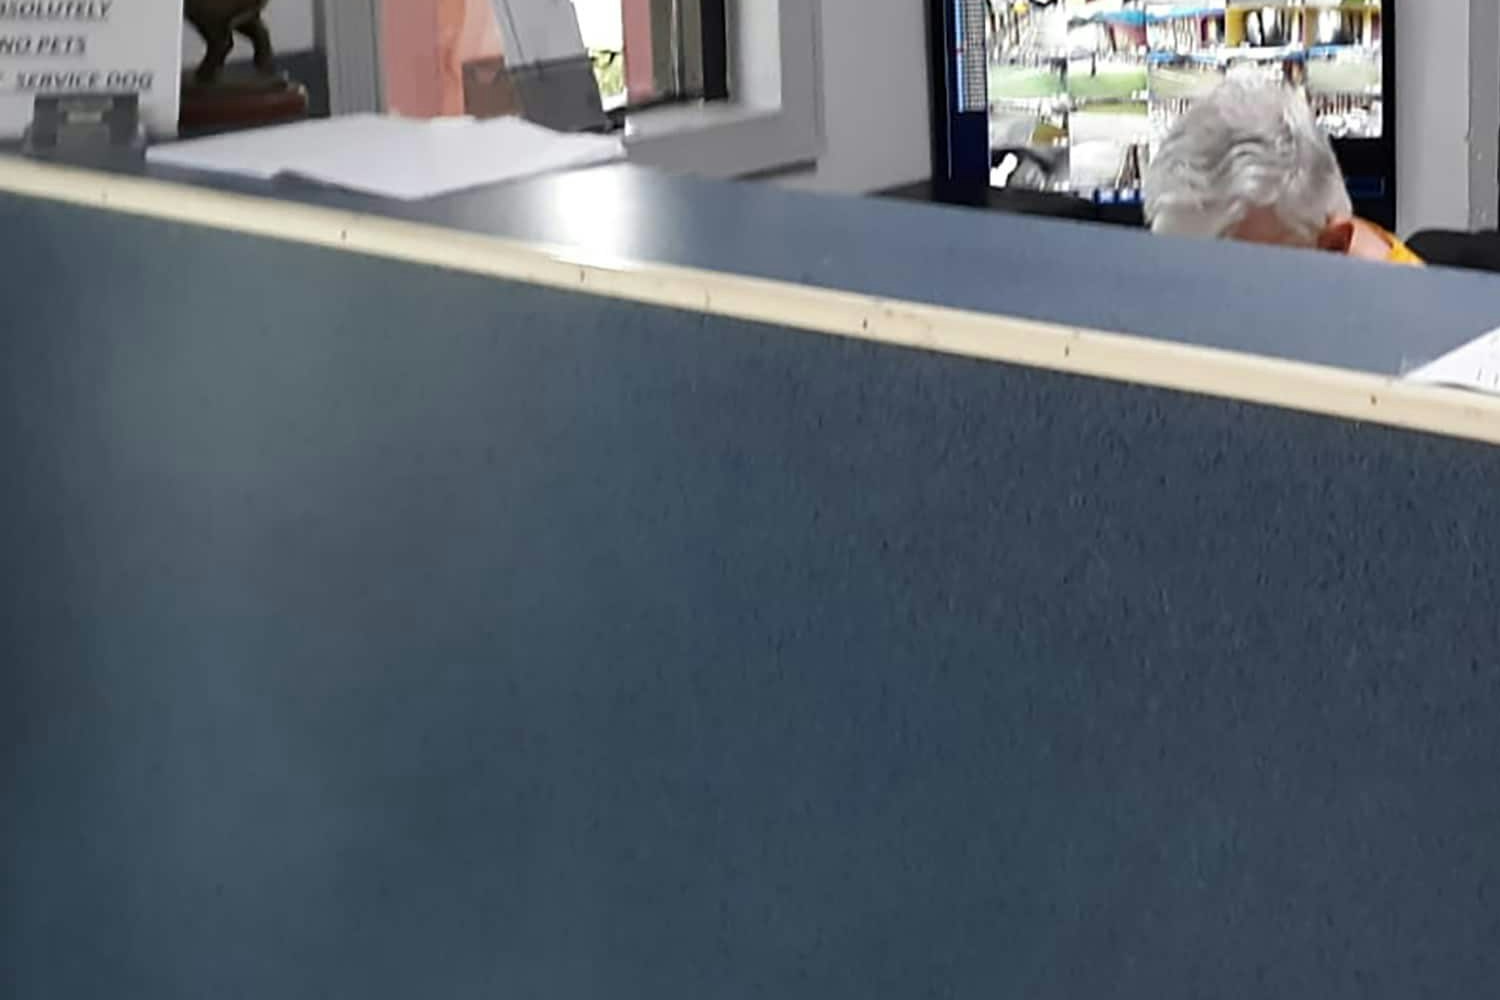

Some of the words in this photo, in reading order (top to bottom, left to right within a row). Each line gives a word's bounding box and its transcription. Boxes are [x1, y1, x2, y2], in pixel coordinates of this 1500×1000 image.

[37, 36, 86, 55] PETS
[16, 71, 98, 90] SERVICE
[104, 70, 154, 89] DOG
